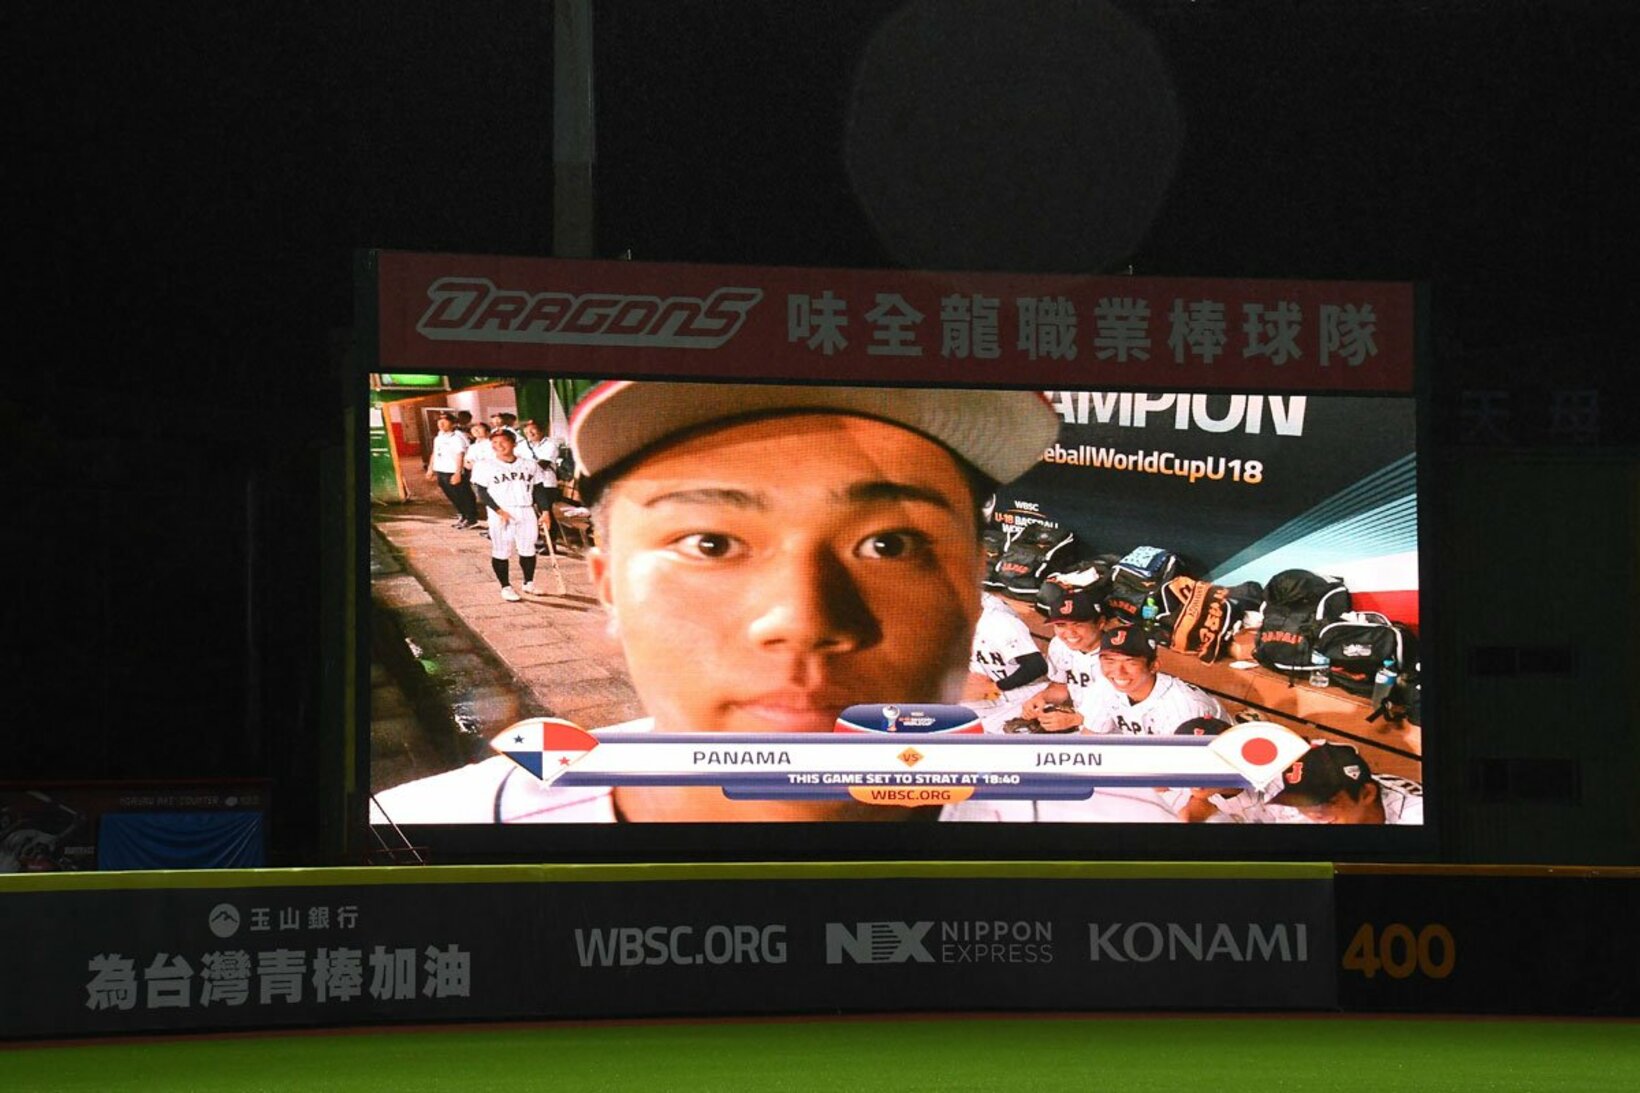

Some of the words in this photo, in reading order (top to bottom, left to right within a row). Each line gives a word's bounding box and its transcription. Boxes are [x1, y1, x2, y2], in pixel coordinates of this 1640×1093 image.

[786, 289, 1379, 367] 味全龍職業棒球隊
[1041, 443, 1264, 484] eballWorldCupU18
[493, 472, 534, 484] JAPAN
[1110, 629, 1128, 646] J
[692, 750, 792, 766] PANAMA
[902, 752, 919, 762] VS
[1034, 751, 1104, 767] JAPAN
[787, 773, 820, 785] THIS
[822, 773, 863, 785] GAME
[866, 773, 893, 785] SET
[894, 773, 913, 785] TO
[915, 773, 959, 785] STRAT
[961, 773, 979, 785] AT
[982, 773, 1021, 785] 18:40
[870, 789, 952, 802] WBSC.ORG
[249, 905, 359, 932] 玉山銀行
[941, 920, 1054, 942] NIPPON
[574, 923, 788, 968] WBSC.ORG
[1088, 921, 1309, 964] KONAMI
[1342, 919, 1457, 980] 400
[940, 943, 1055, 965] EXPRESS
[85, 943, 472, 1011] 為台灣青棒加油
